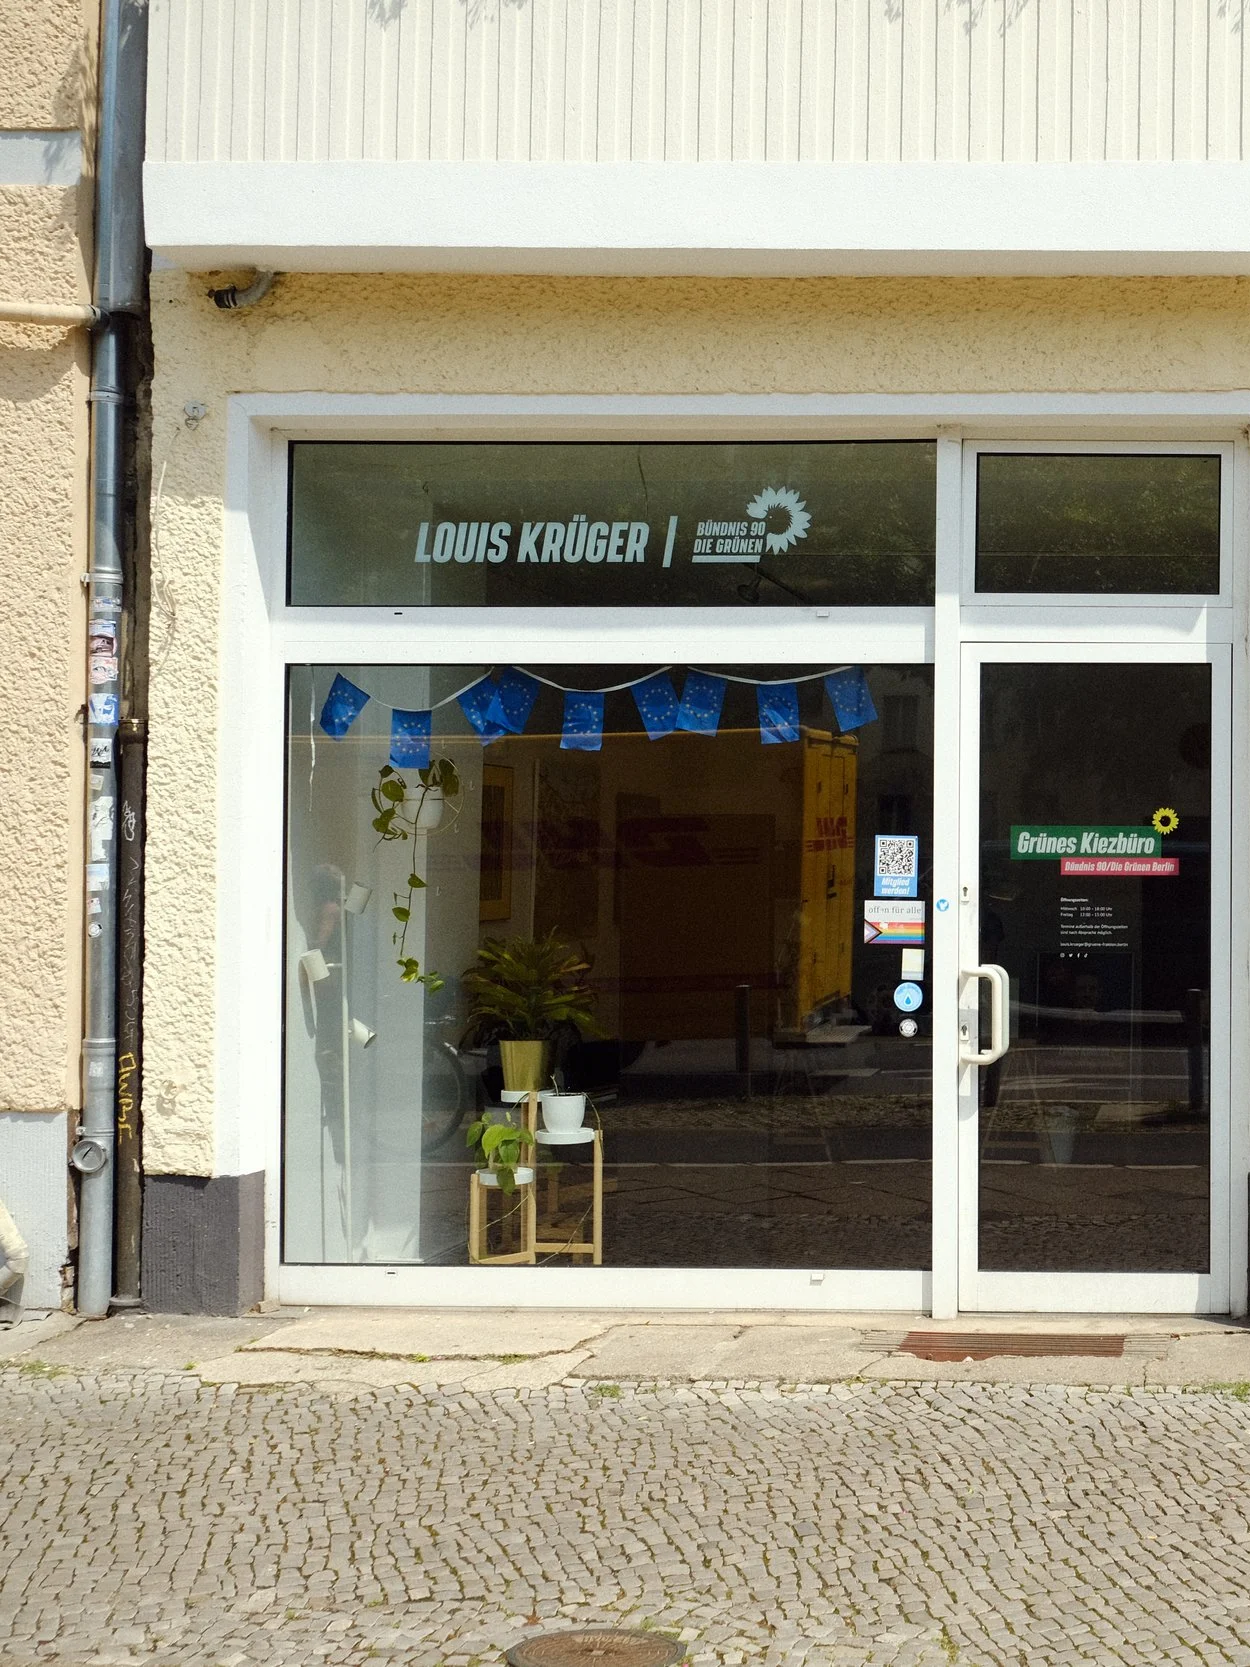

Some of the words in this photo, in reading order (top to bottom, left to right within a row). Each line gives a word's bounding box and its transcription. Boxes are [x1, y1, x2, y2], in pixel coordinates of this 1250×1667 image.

[696, 520, 748, 537] BÜNDNIS
[750, 521, 766, 537] 90
[414, 521, 511, 563] LOUIS
[516, 514, 650, 563] KRÜGER
[693, 537, 713, 553] DIE
[715, 536, 764, 553] GRÜNEN
[1017, 831, 1077, 854] Grünes
[1080, 832, 1155, 854] Kiezbüro
[1064, 861, 1095, 872] Bündnis
[1096, 861, 1122, 872] 90/Die
[1124, 861, 1151, 872] Grünen
[1152, 861, 1175, 872] Berlin
[881, 877, 910, 887] Mitglied
[881, 887, 910, 895] werden!
[892, 906, 905, 914] für
[906, 906, 922, 914] alle
